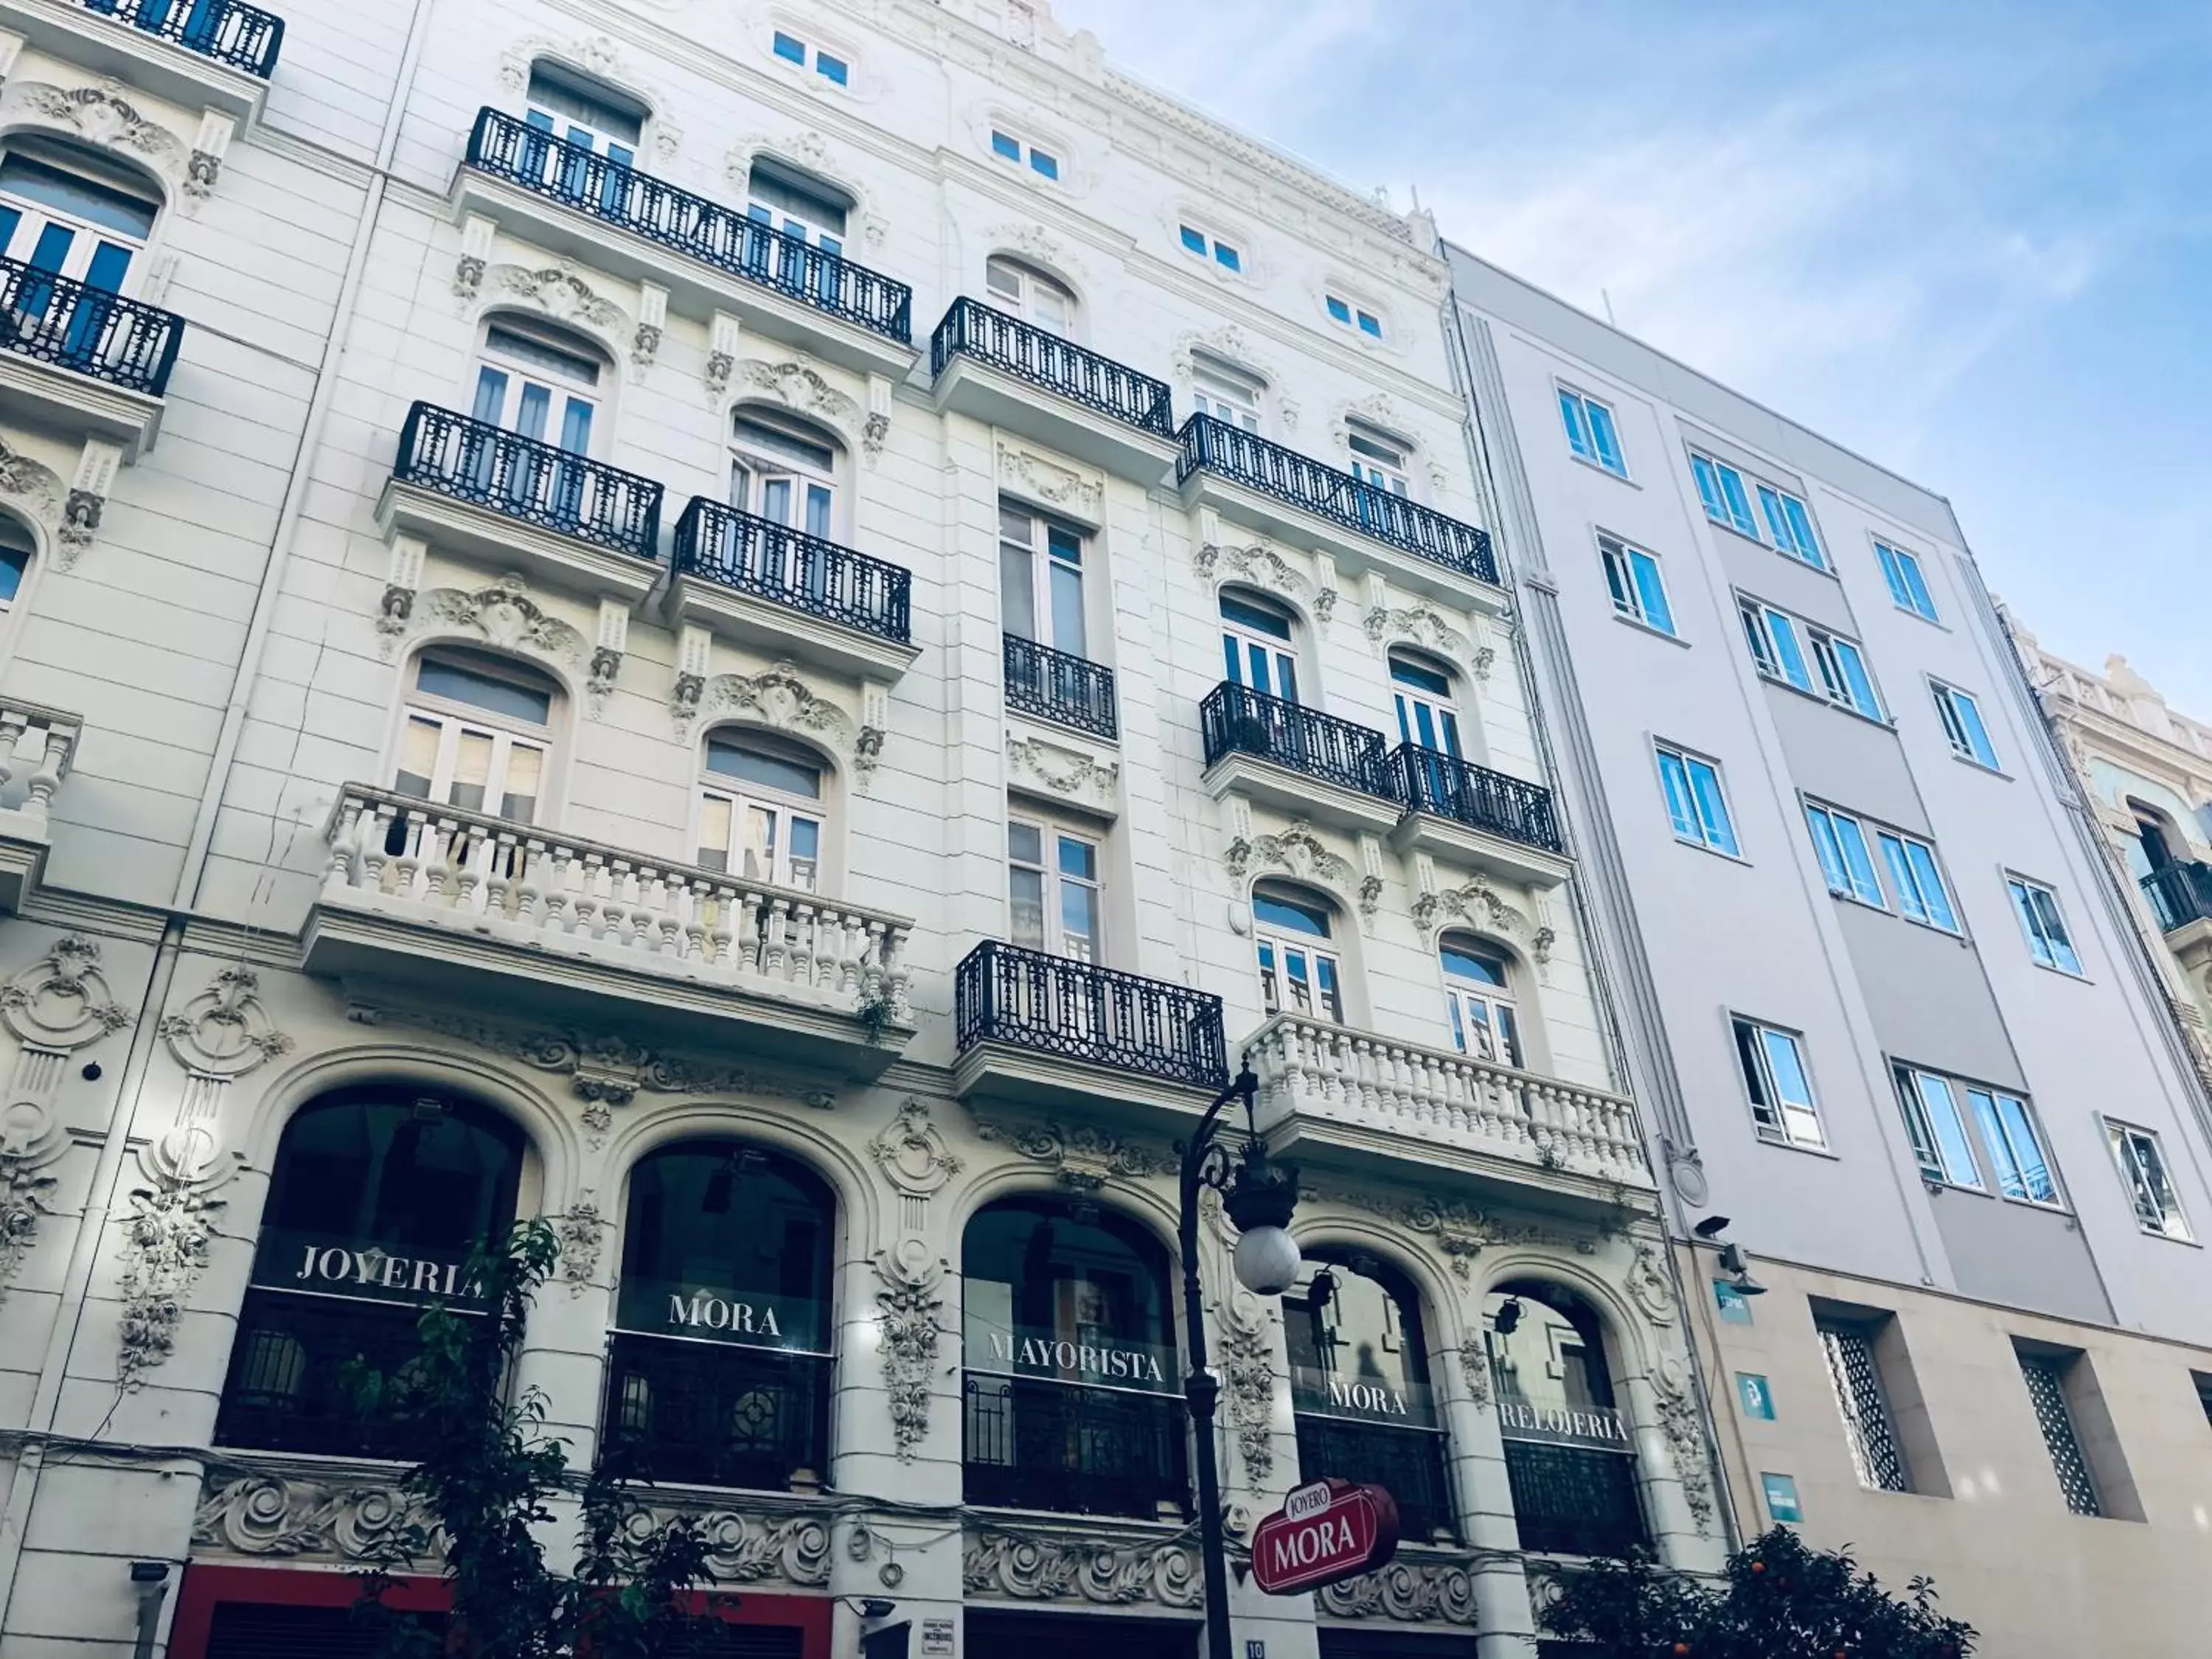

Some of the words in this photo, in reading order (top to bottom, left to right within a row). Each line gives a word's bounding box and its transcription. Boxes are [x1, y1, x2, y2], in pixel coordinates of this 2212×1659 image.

[296, 1245, 484, 1298] JOYERIA
[668, 1294, 782, 1337] MORA
[989, 1332, 1163, 1382] MAYORISTA
[1328, 1381, 1406, 1415] MORA
[1500, 1403, 1628, 1441] RELOJERIA
[1291, 1487, 1326, 1517] JOYERO
[1275, 1515, 1355, 1573] MORA
[1249, 1643, 1262, 1658] 10
